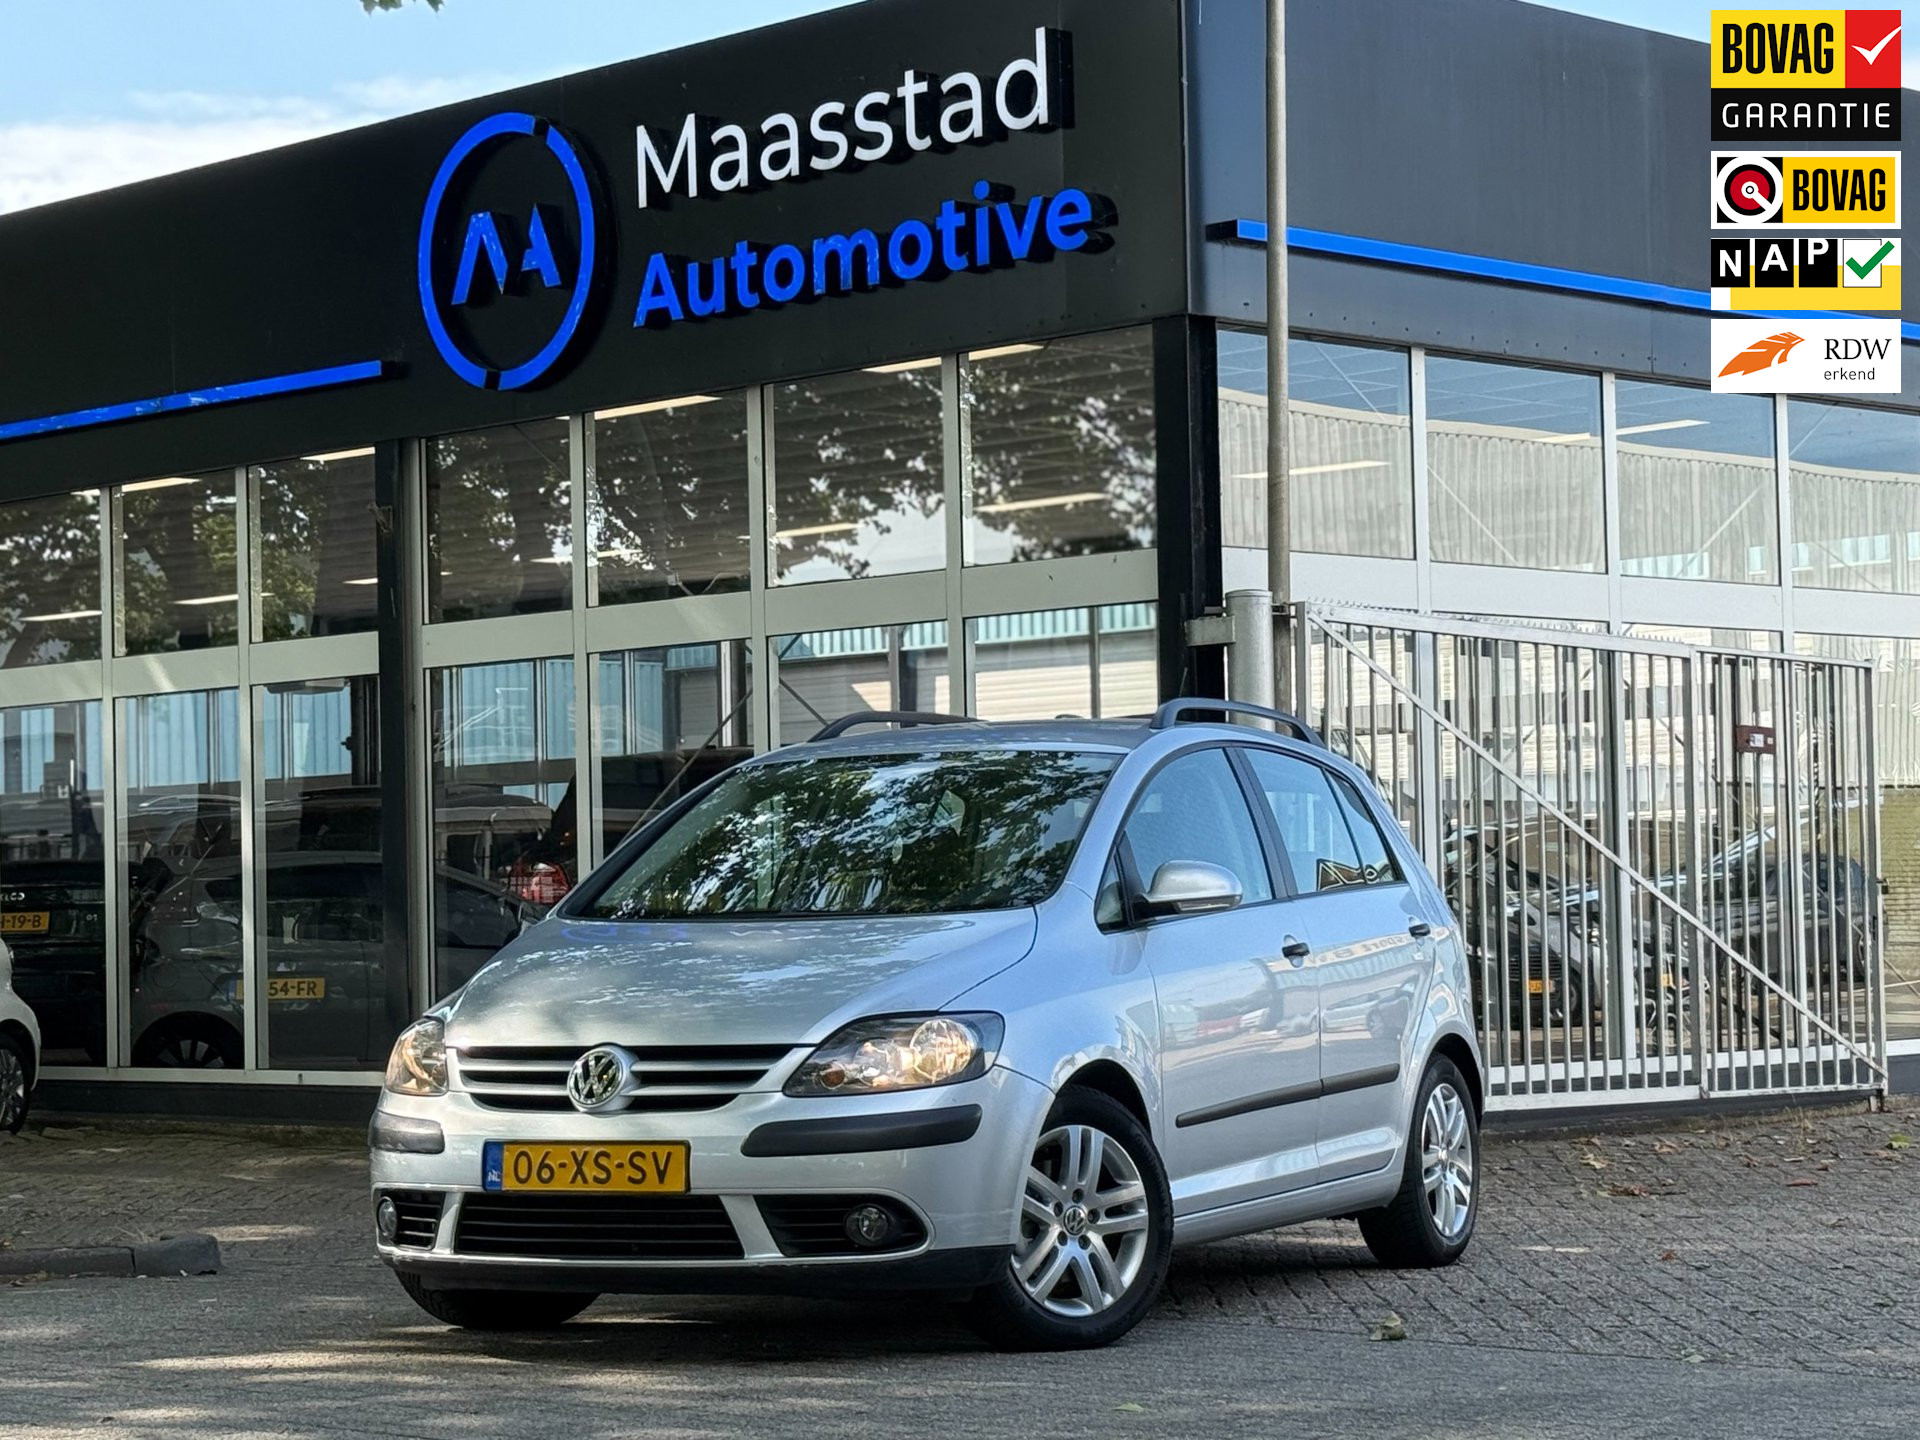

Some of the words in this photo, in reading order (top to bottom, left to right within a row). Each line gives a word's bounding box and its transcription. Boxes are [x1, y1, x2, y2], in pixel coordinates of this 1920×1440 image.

[635, 26, 1050, 209] Maasstad
[633, 180, 1092, 328] Automotive
[512, 1150, 673, 1185] 06-XS-SV
